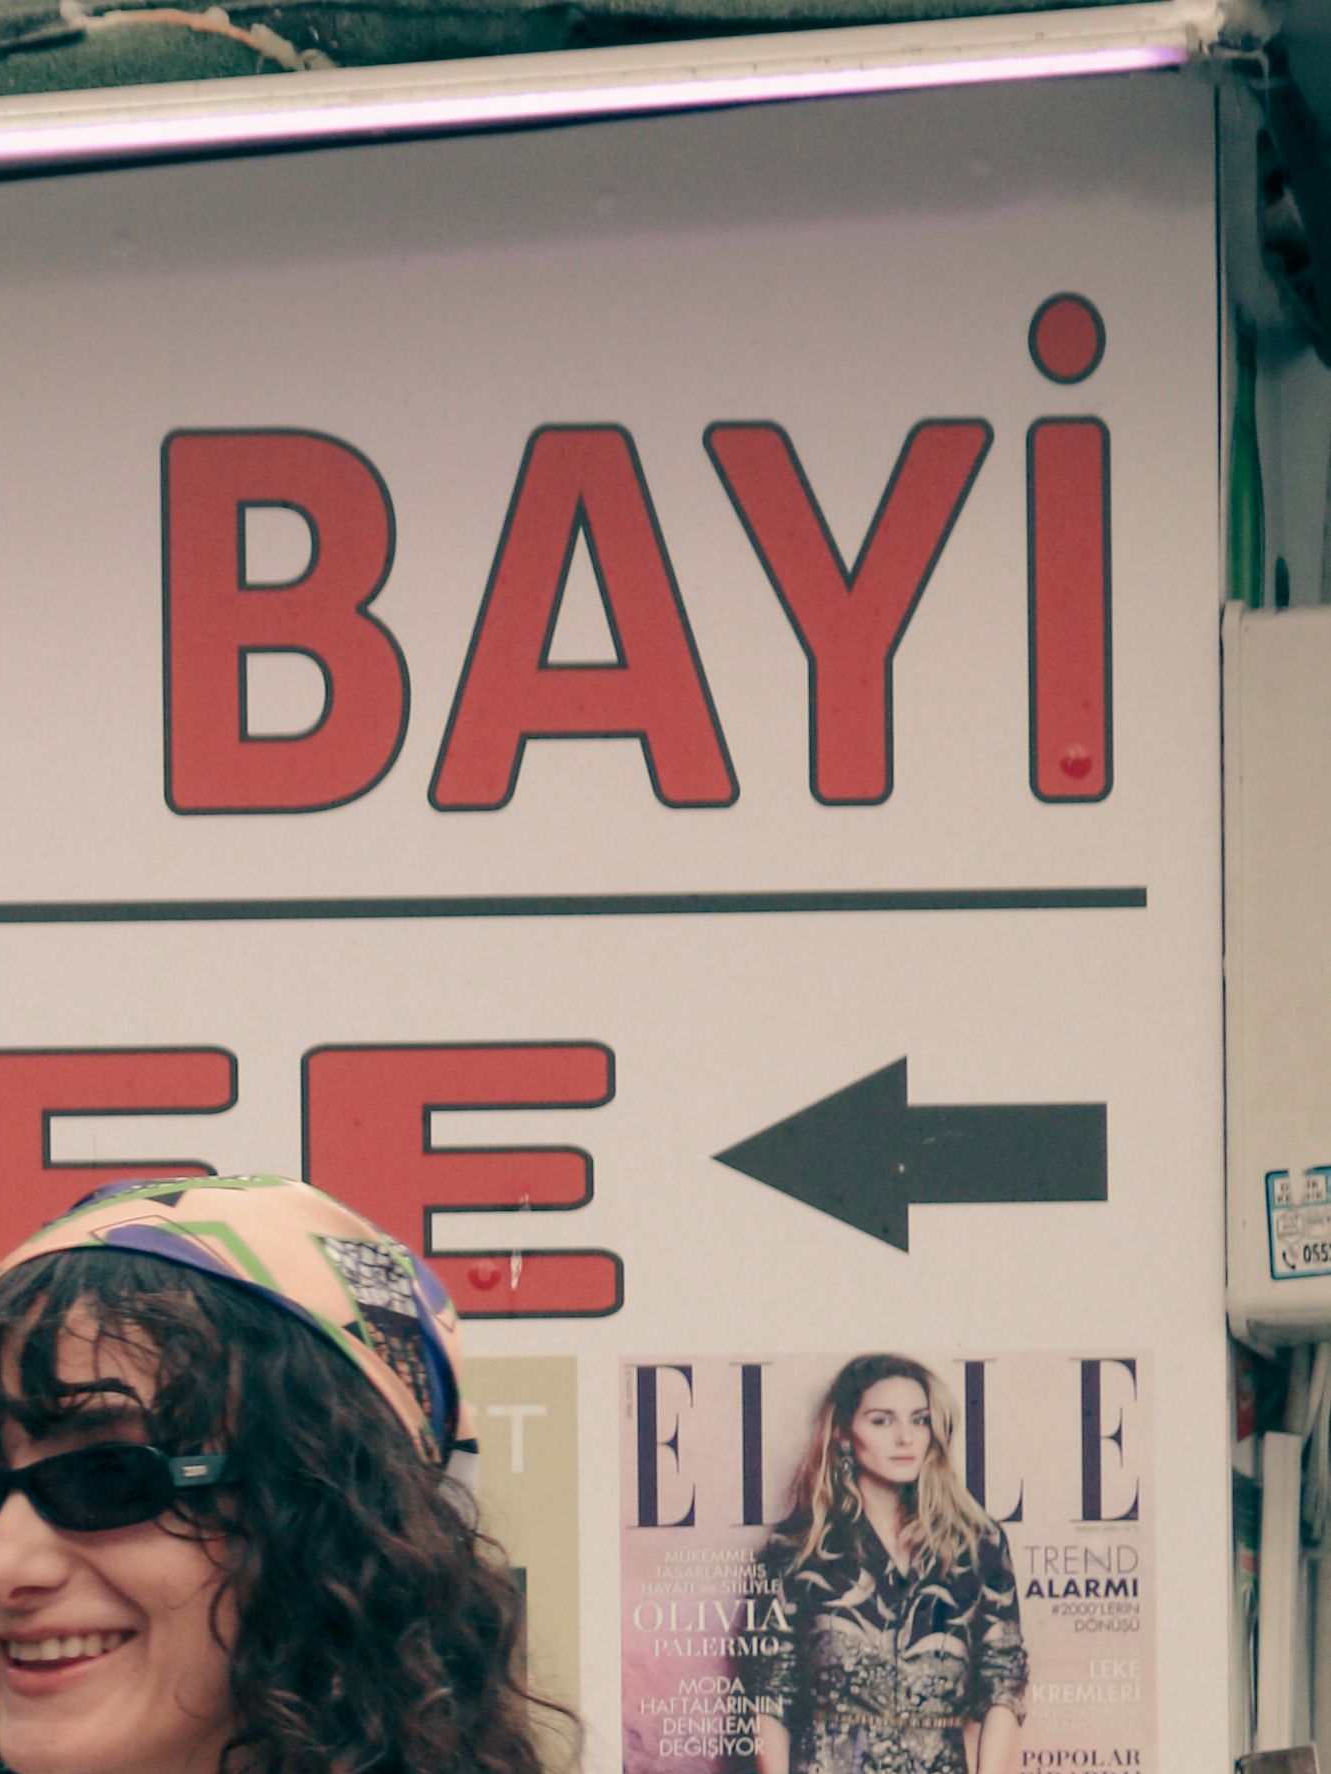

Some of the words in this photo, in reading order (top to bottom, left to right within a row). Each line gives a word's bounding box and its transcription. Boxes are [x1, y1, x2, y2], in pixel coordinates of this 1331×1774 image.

[162, 292, 1112, 812] BAYİ
[625, 1357, 1139, 1530] ELLE
[1024, 1545, 1139, 1574] TREND
[633, 1598, 794, 1633] OLIVIA
[654, 1636, 780, 1657] PALERMO
[678, 1676, 745, 1694] MODA
[640, 1696, 783, 1715] HAFTALARININ
[659, 1735, 763, 1759] DEĞİŞİYOR
[1022, 1749, 1141, 1768] POPOLAR
